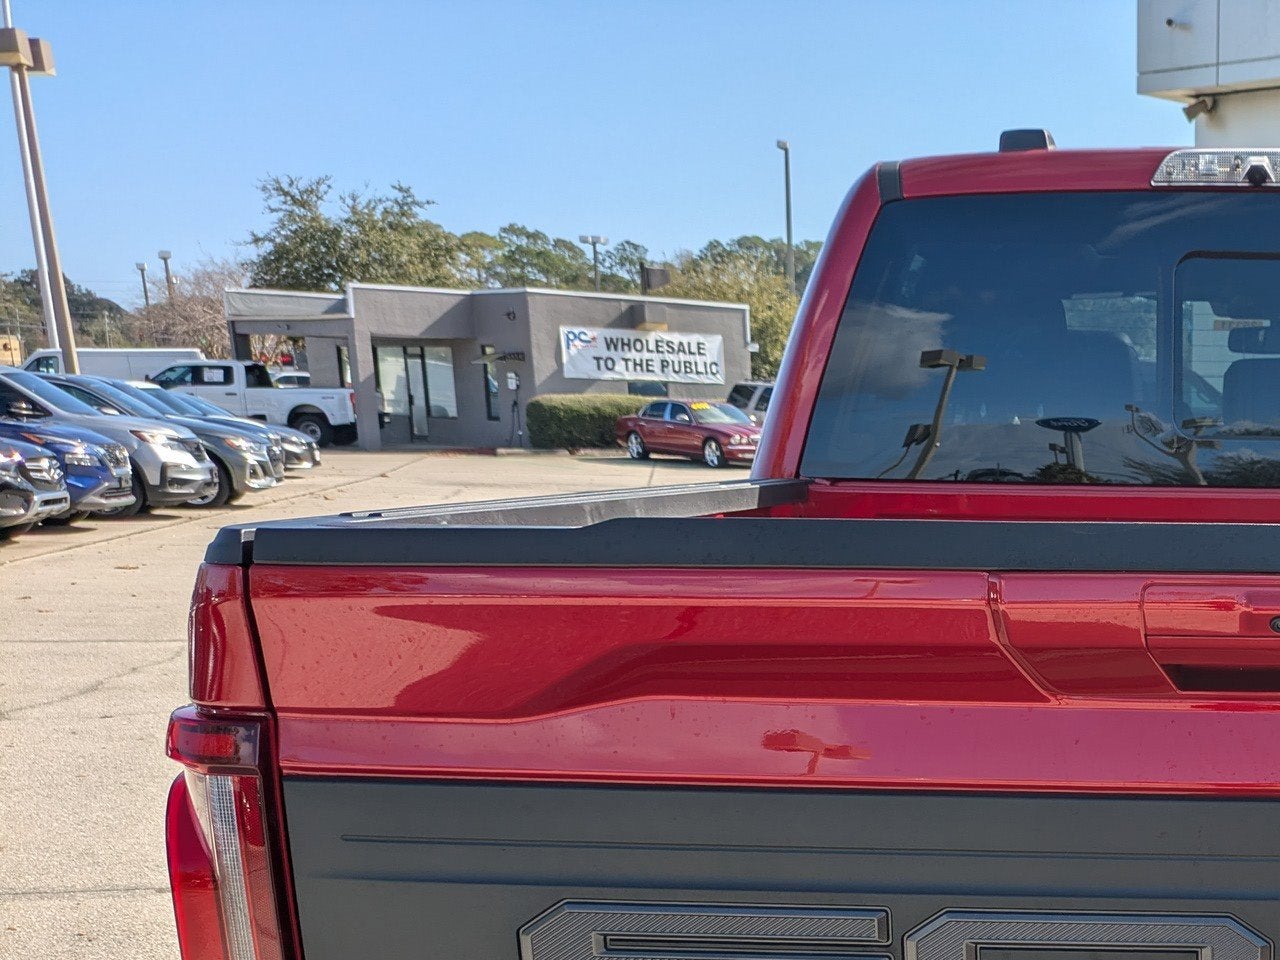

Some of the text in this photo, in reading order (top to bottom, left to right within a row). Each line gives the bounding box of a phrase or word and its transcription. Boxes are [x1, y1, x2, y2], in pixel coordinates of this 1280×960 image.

[604, 336, 706, 356] WHOLESALE
[593, 356, 720, 376] TO THE PUBLIC
